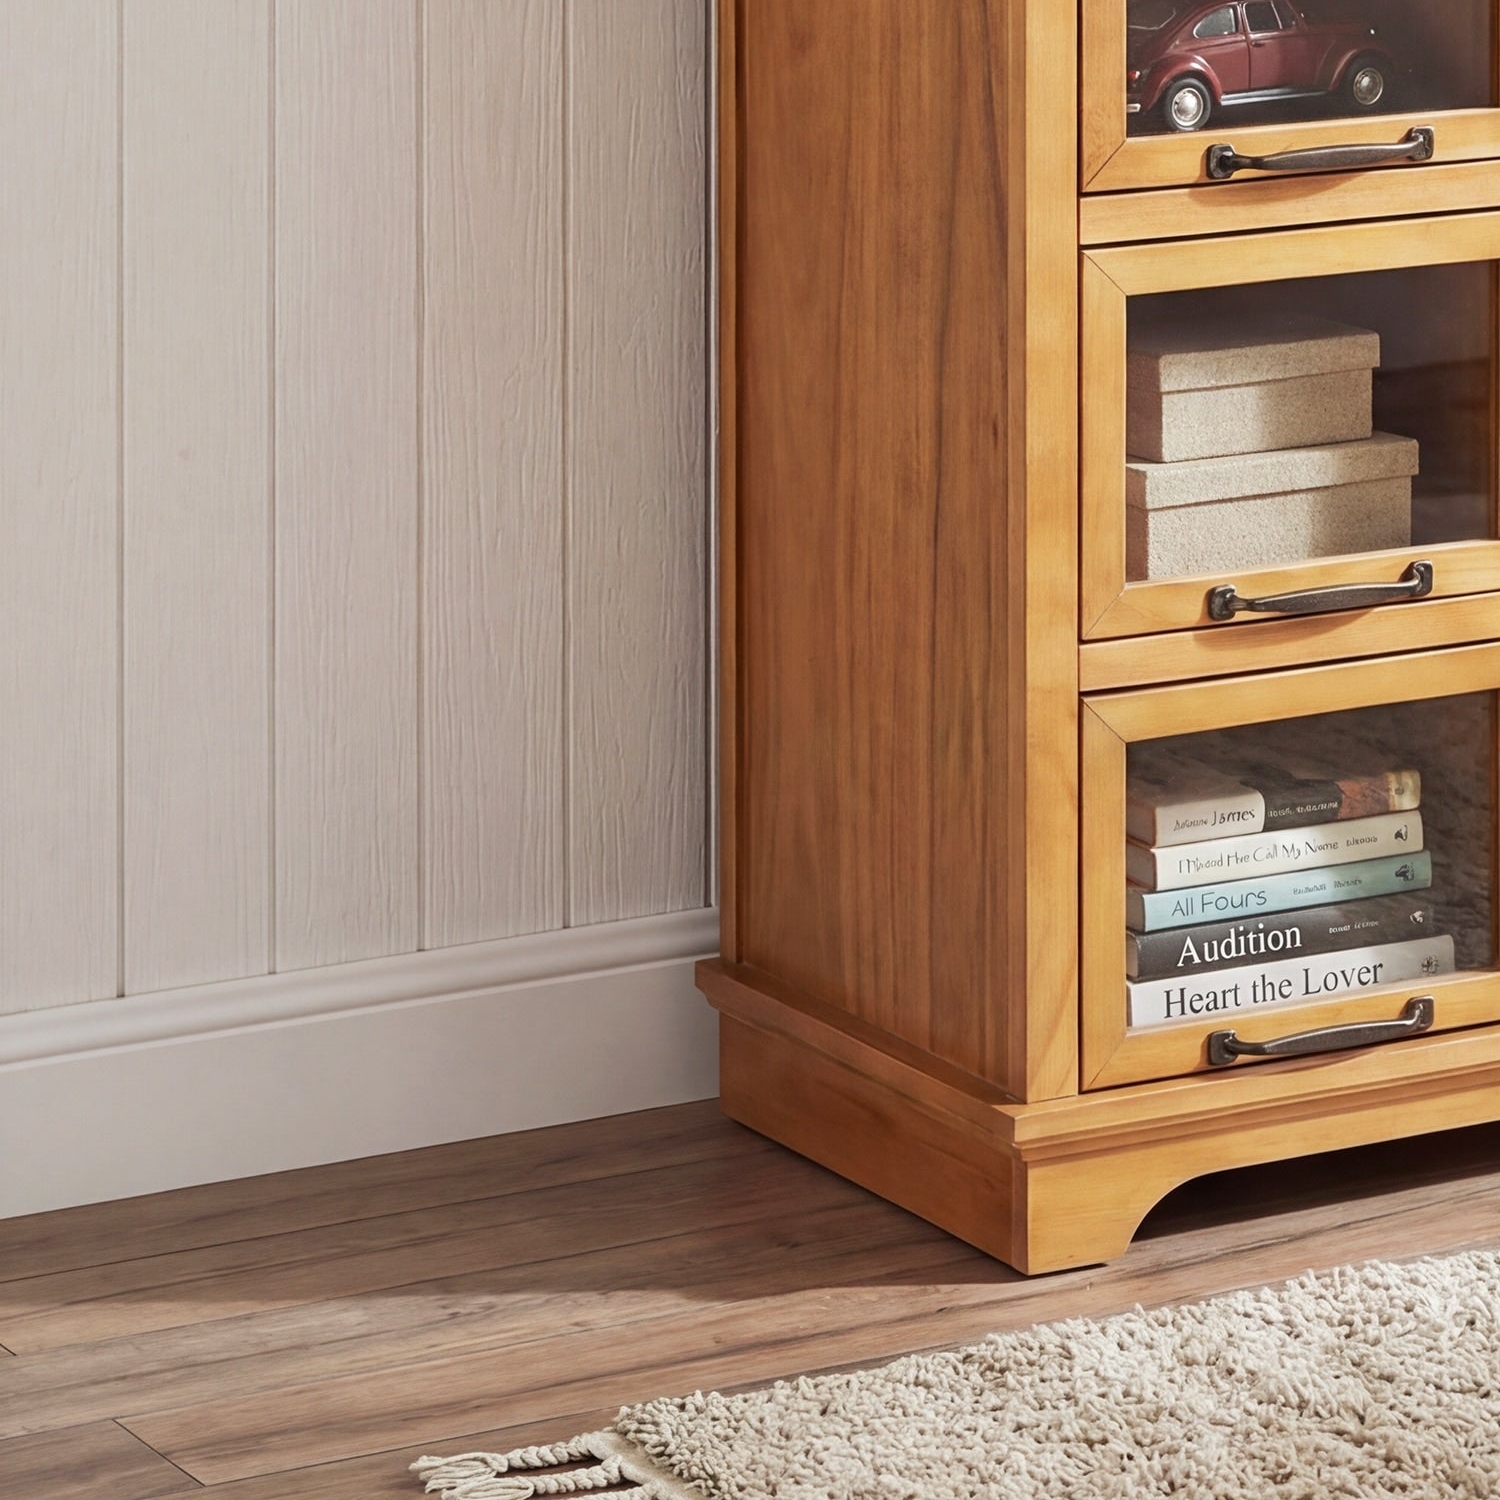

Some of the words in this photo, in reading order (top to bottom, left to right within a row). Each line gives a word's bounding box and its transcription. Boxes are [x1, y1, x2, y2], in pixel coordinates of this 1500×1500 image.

[1171, 896, 1194, 918] All
[1201, 889, 1267, 913] Fours
[1176, 923, 1302, 968] Audition
[1163, 983, 1242, 1020] Heart
[1251, 973, 1293, 1005] the
[1302, 961, 1384, 997] Lover
